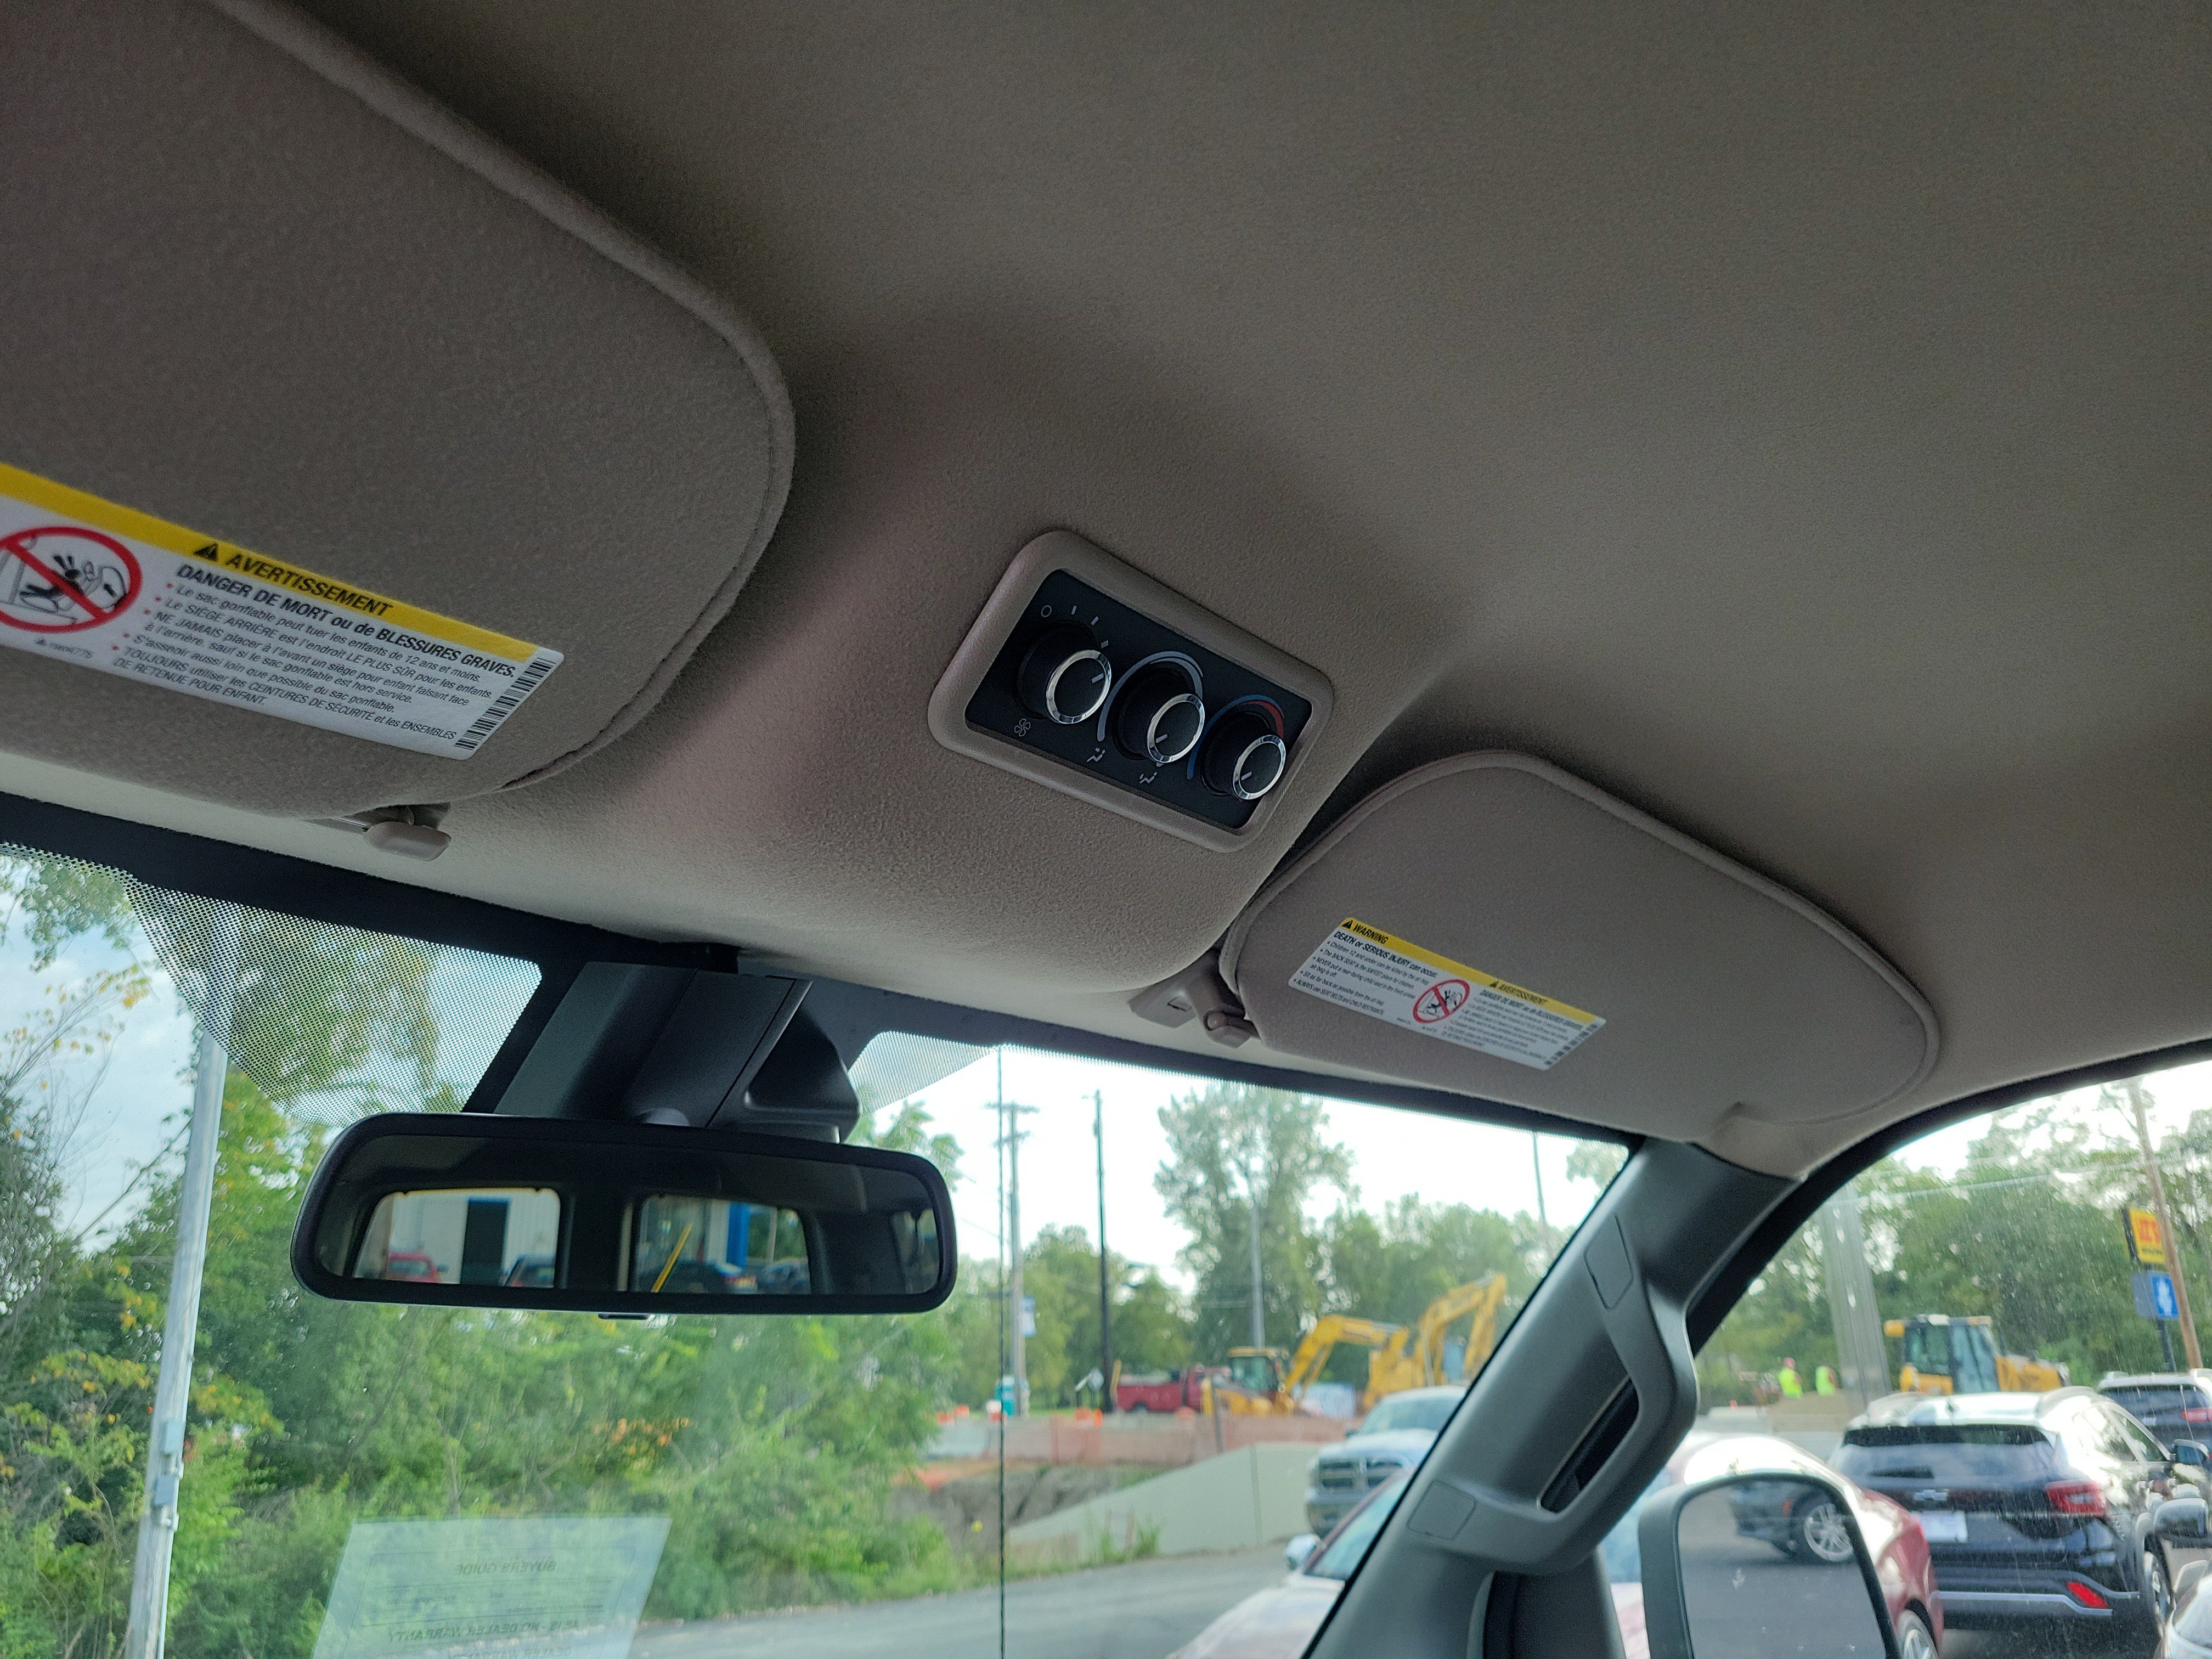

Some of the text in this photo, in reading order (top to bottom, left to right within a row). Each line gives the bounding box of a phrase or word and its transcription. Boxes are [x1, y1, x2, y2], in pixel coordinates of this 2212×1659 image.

[177, 564, 516, 678] DANGER DE MORT ou de BLESSURES GRAVES.
[225, 554, 393, 616] AVERTISSEMENT
[154, 611, 470, 706] NE JAMAIS placer à l'avant un siège pour enfant faisant face
[165, 599, 183, 610] Le
[223, 617, 278, 638] ARRIÈRE
[278, 634, 299, 645] est
[298, 638, 347, 658] l'endroit
[345, 652, 364, 663] LE
[362, 657, 393, 672] PLUS
[392, 665, 416, 678] SÛR
[413, 673, 441, 684] pour
[438, 678, 456, 689] les
[455, 684, 492, 699] enfants.
[176, 585, 480, 682] Le sac gonflable peut tuer les enfants de 12 ans et moins.
[208, 642, 236, 654] sauf
[235, 650, 249, 658] si
[248, 652, 261, 662] le
[261, 657, 283, 668] sac
[282, 663, 333, 682] gonflable
[334, 678, 352, 687] est
[351, 681, 376, 693] hors
[375, 689, 412, 703] service.
[113, 657, 267, 705] DE RETENUE POUR ENFANT.
[125, 646, 457, 740] TOUJOURS utiliser les CEINTURES DE SÉCURITÉ et les ENSEMBLES
[133, 634, 394, 713] S'asseoir aussi loin que possible du sac gonflable.
[1334, 931, 1356, 944] DEATH
[1363, 943, 1389, 958] SERIOUS
[1353, 924, 1389, 945] WARNING
